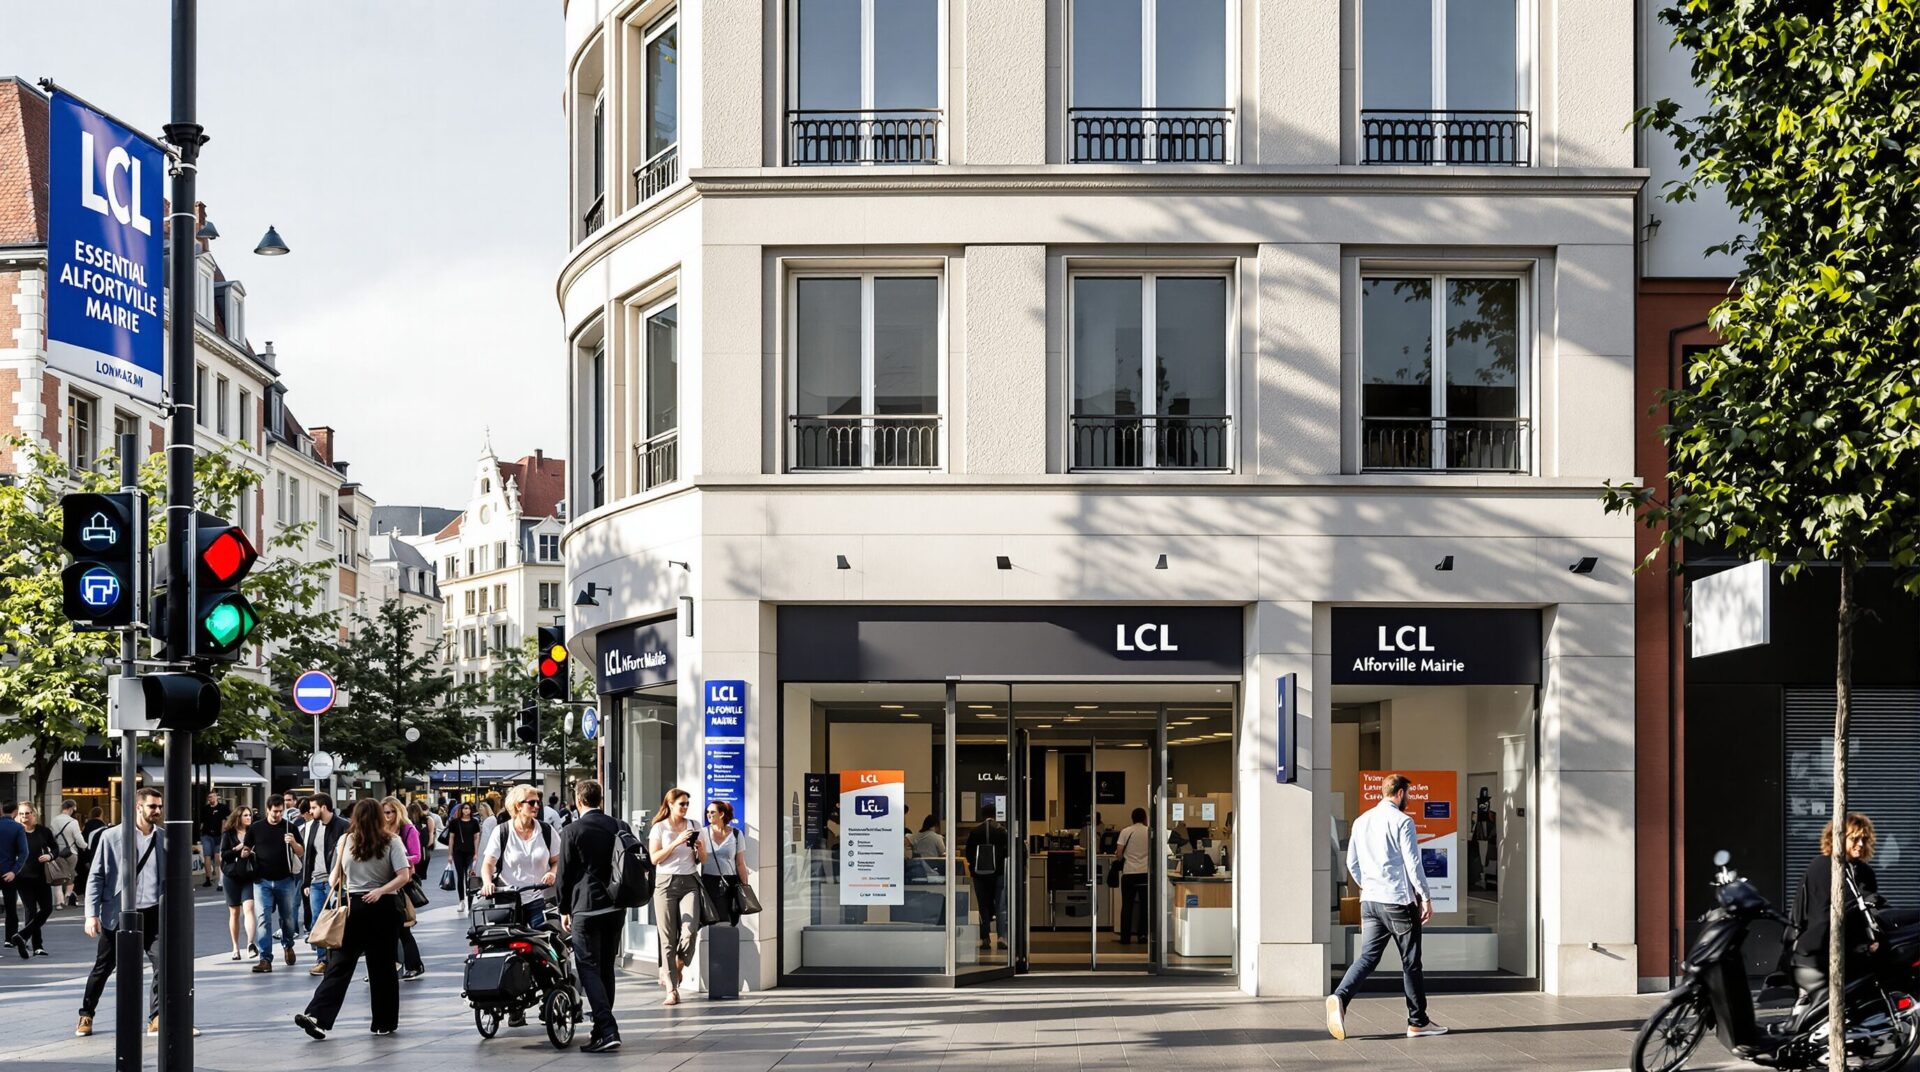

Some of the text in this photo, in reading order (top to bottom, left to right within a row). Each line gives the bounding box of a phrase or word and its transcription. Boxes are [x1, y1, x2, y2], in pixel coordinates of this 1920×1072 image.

[82, 131, 151, 236] LCL
[75, 240, 147, 288] ESSENTIAL
[60, 263, 157, 317] ALFORTVILLE
[86, 297, 140, 333] MAIRIE
[1116, 623, 1178, 651] LCL
[1378, 625, 1435, 651] LCL
[605, 649, 622, 676] LCL
[1352, 657, 1465, 672] Alforville Mairie
[711, 686, 738, 701] LCL
[860, 774, 878, 783] LCL
